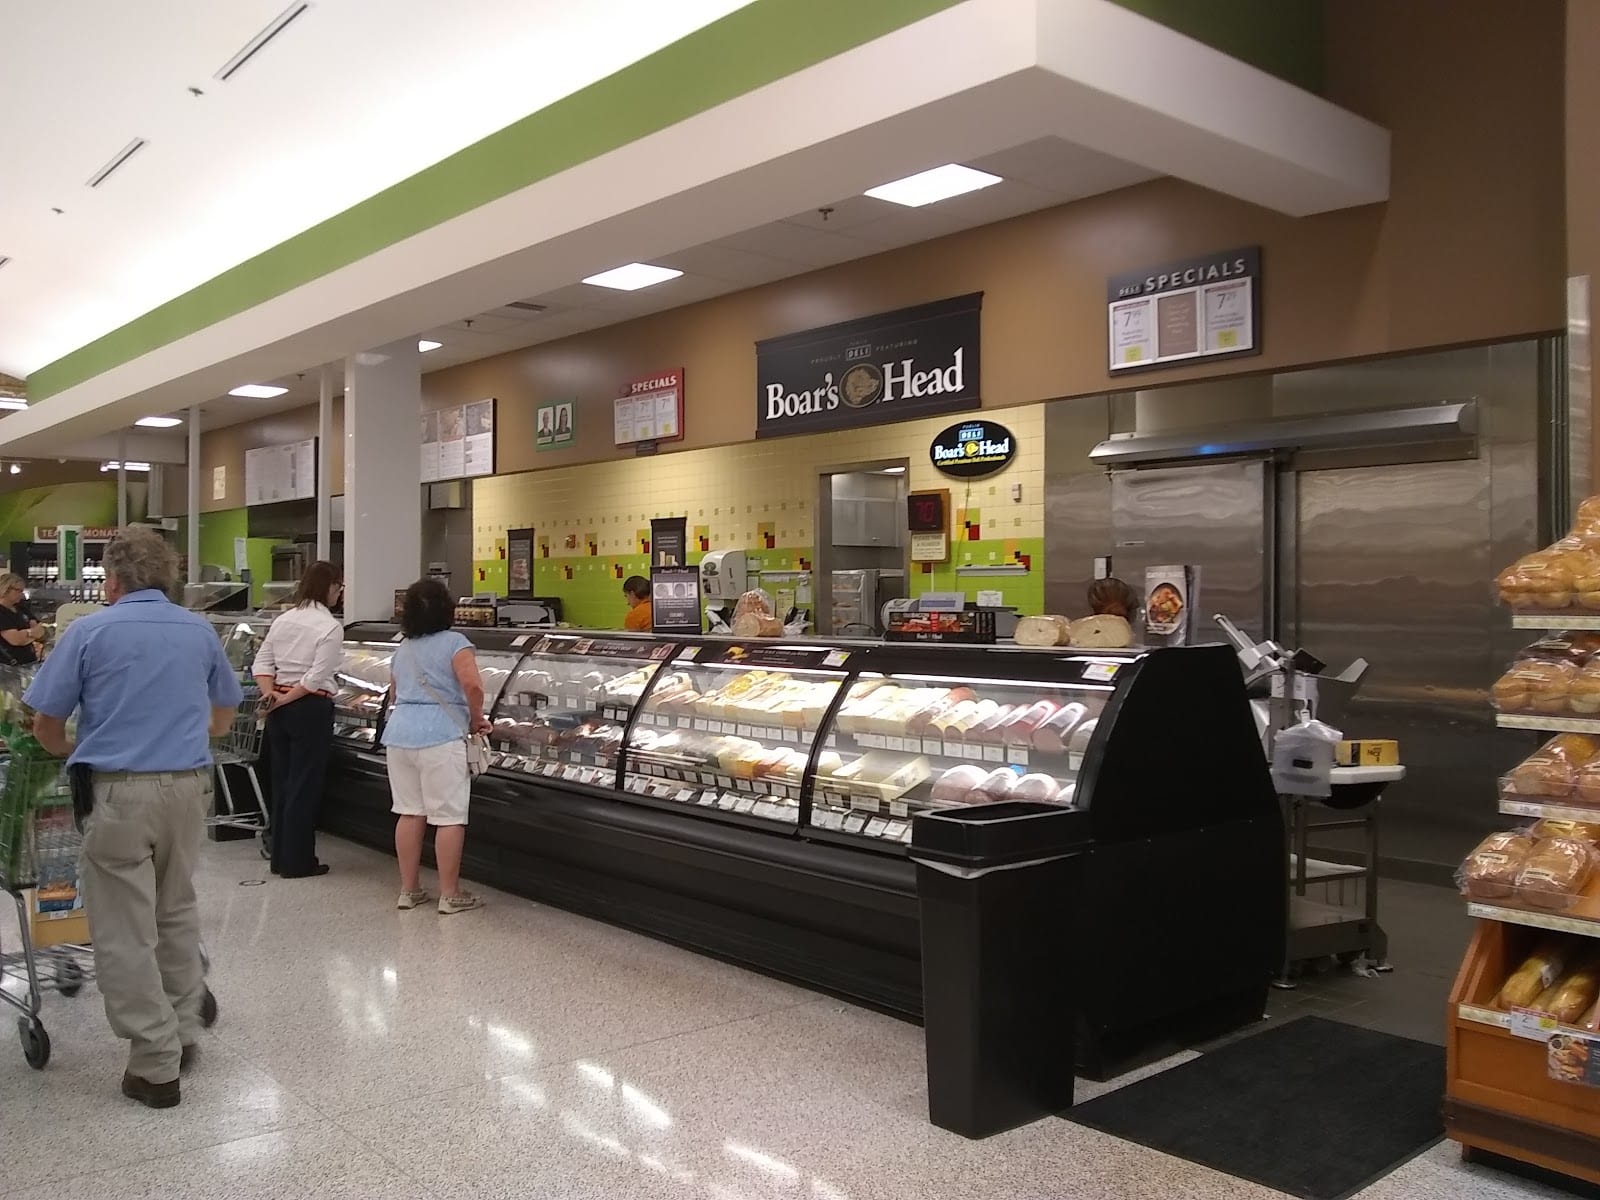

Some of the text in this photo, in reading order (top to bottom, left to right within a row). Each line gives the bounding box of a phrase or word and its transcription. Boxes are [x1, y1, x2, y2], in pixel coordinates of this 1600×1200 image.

[1144, 258, 1246, 292] SPECIALS
[848, 347, 869, 358] DELI
[631, 375, 677, 393] SPECIALS
[766, 347, 965, 420] Boar's Head
[961, 430, 981, 440] DELI
[934, 437, 1010, 460] Boar's Head
[84, 528, 119, 538] MONAD
